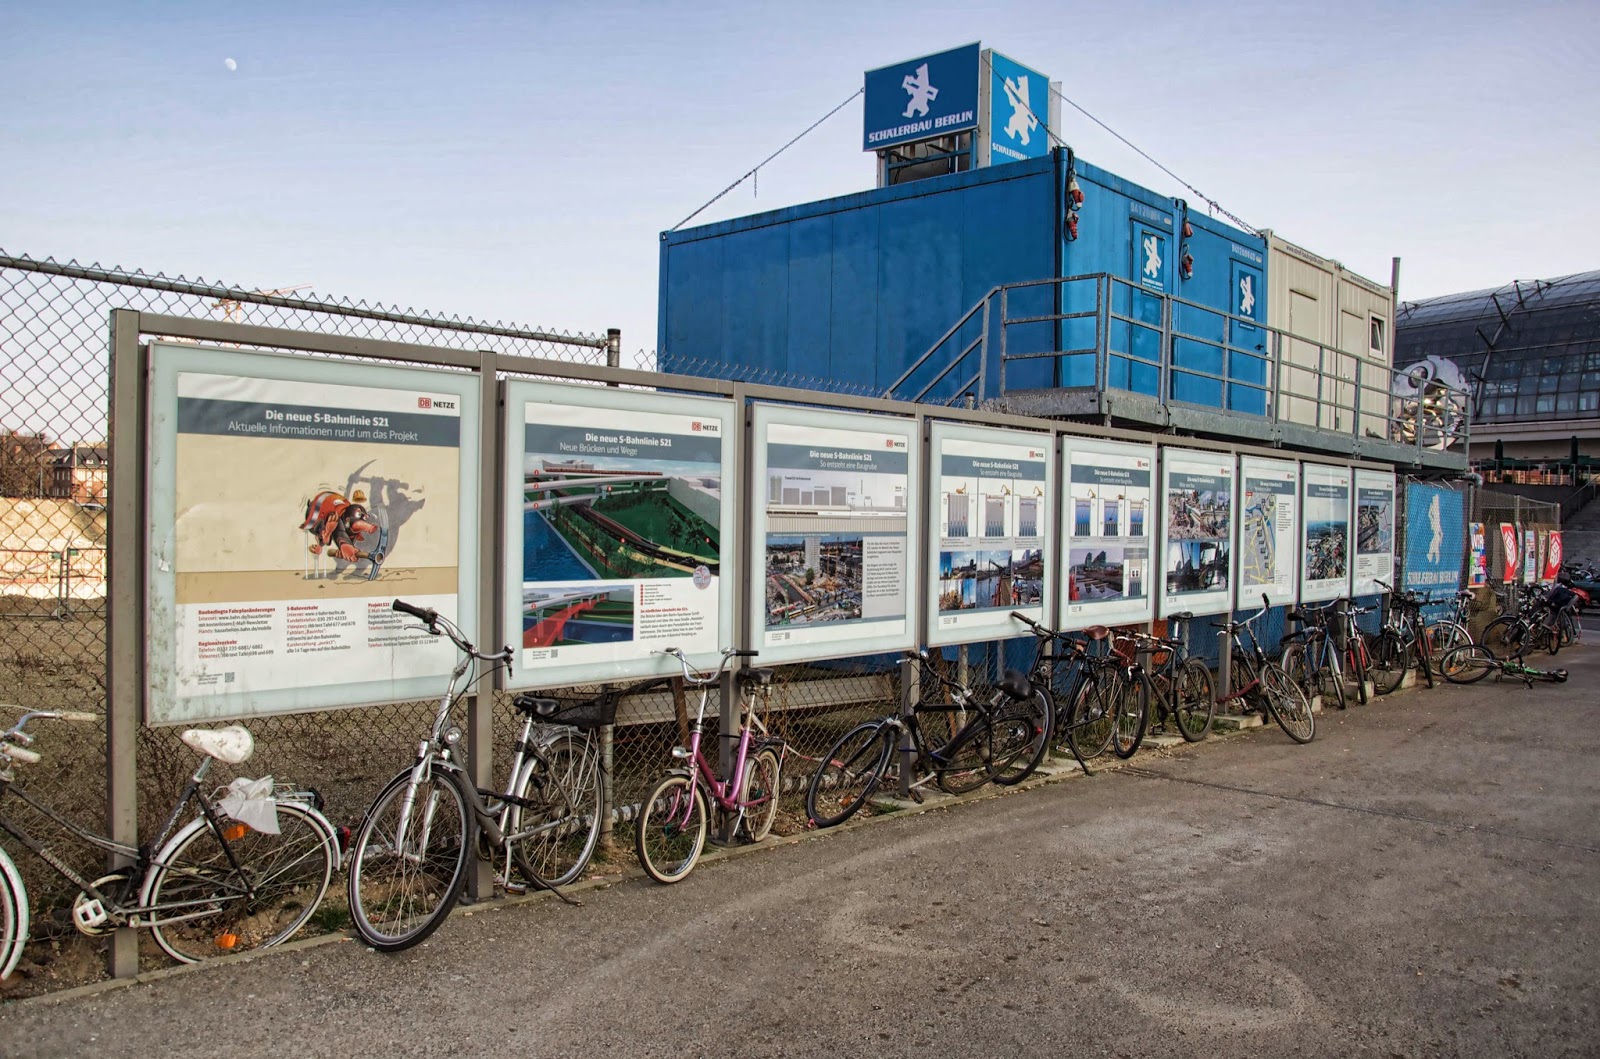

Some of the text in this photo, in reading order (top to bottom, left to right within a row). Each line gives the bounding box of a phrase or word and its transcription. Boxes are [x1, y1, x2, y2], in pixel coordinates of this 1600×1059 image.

[869, 110, 973, 143] SCHÄLERBAU BERLIN
[419, 398, 455, 410] DB NETZE
[266, 409, 389, 427] Die neue S-Bahnlinie S21
[228, 420, 418, 442] Aktuelle Informationen rund um das Projekt
[586, 433, 598, 442] Die
[619, 436, 659, 446] S-Bahnlinie
[660, 438, 672, 446] S21
[560, 443, 638, 456] Neue Brücken und Wege
